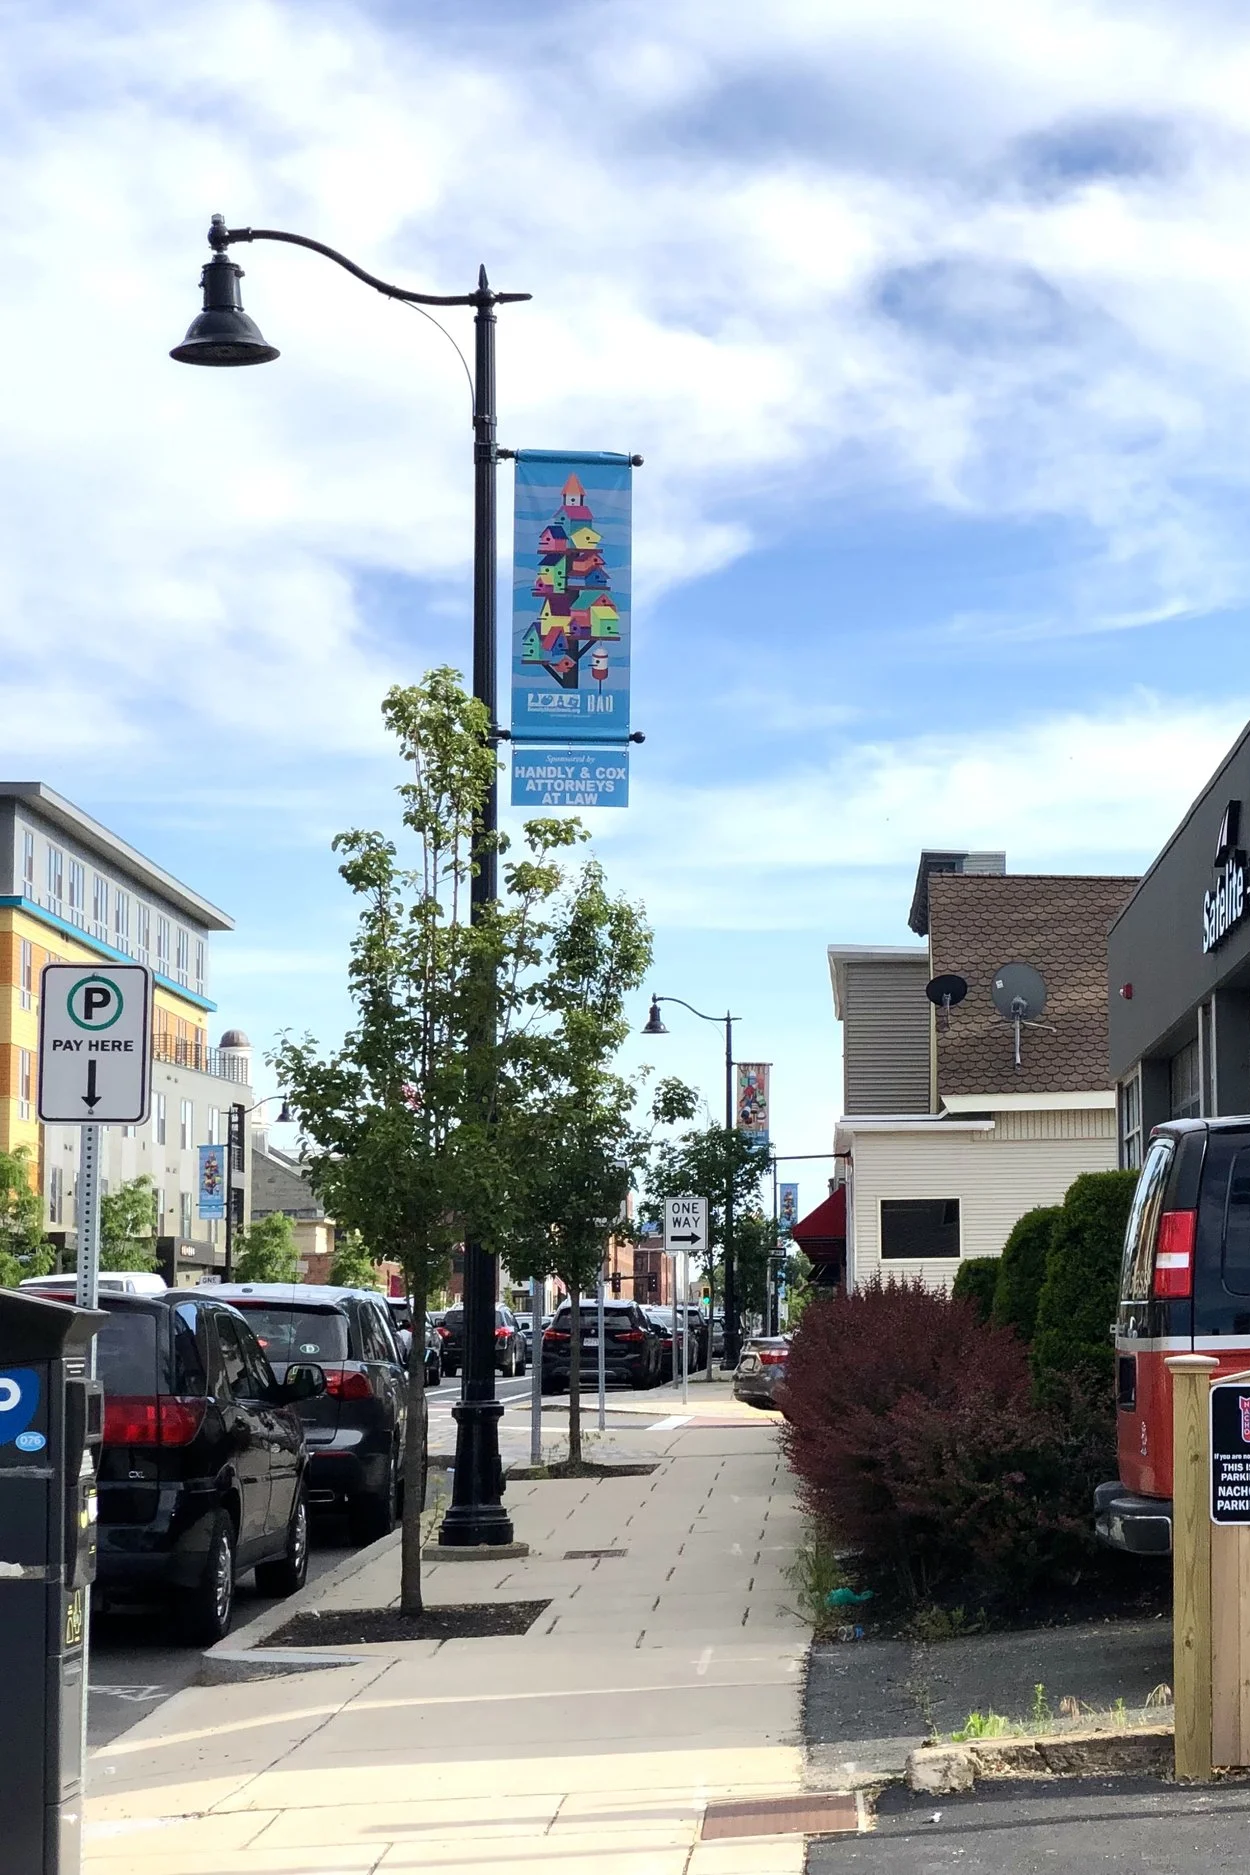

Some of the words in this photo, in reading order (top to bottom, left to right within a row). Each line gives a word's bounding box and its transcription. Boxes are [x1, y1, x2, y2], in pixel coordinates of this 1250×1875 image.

[515, 766, 576, 779] HANDLY
[580, 767, 591, 779] &
[595, 767, 626, 780] COX
[525, 780, 615, 792] ATTORNEYS
[541, 793, 561, 805] AT
[565, 793, 598, 805] LAW
[1203, 857, 1244, 954] Safelite
[84, 987, 111, 1020] P
[52, 1039, 84, 1052] PAY
[88, 1039, 134, 1052] HERE
[672, 1202, 700, 1214] ONE
[672, 1216, 700, 1228] WAY
[19, 1436, 41, 1445] 076
[1222, 1463, 1244, 1472] THIS
